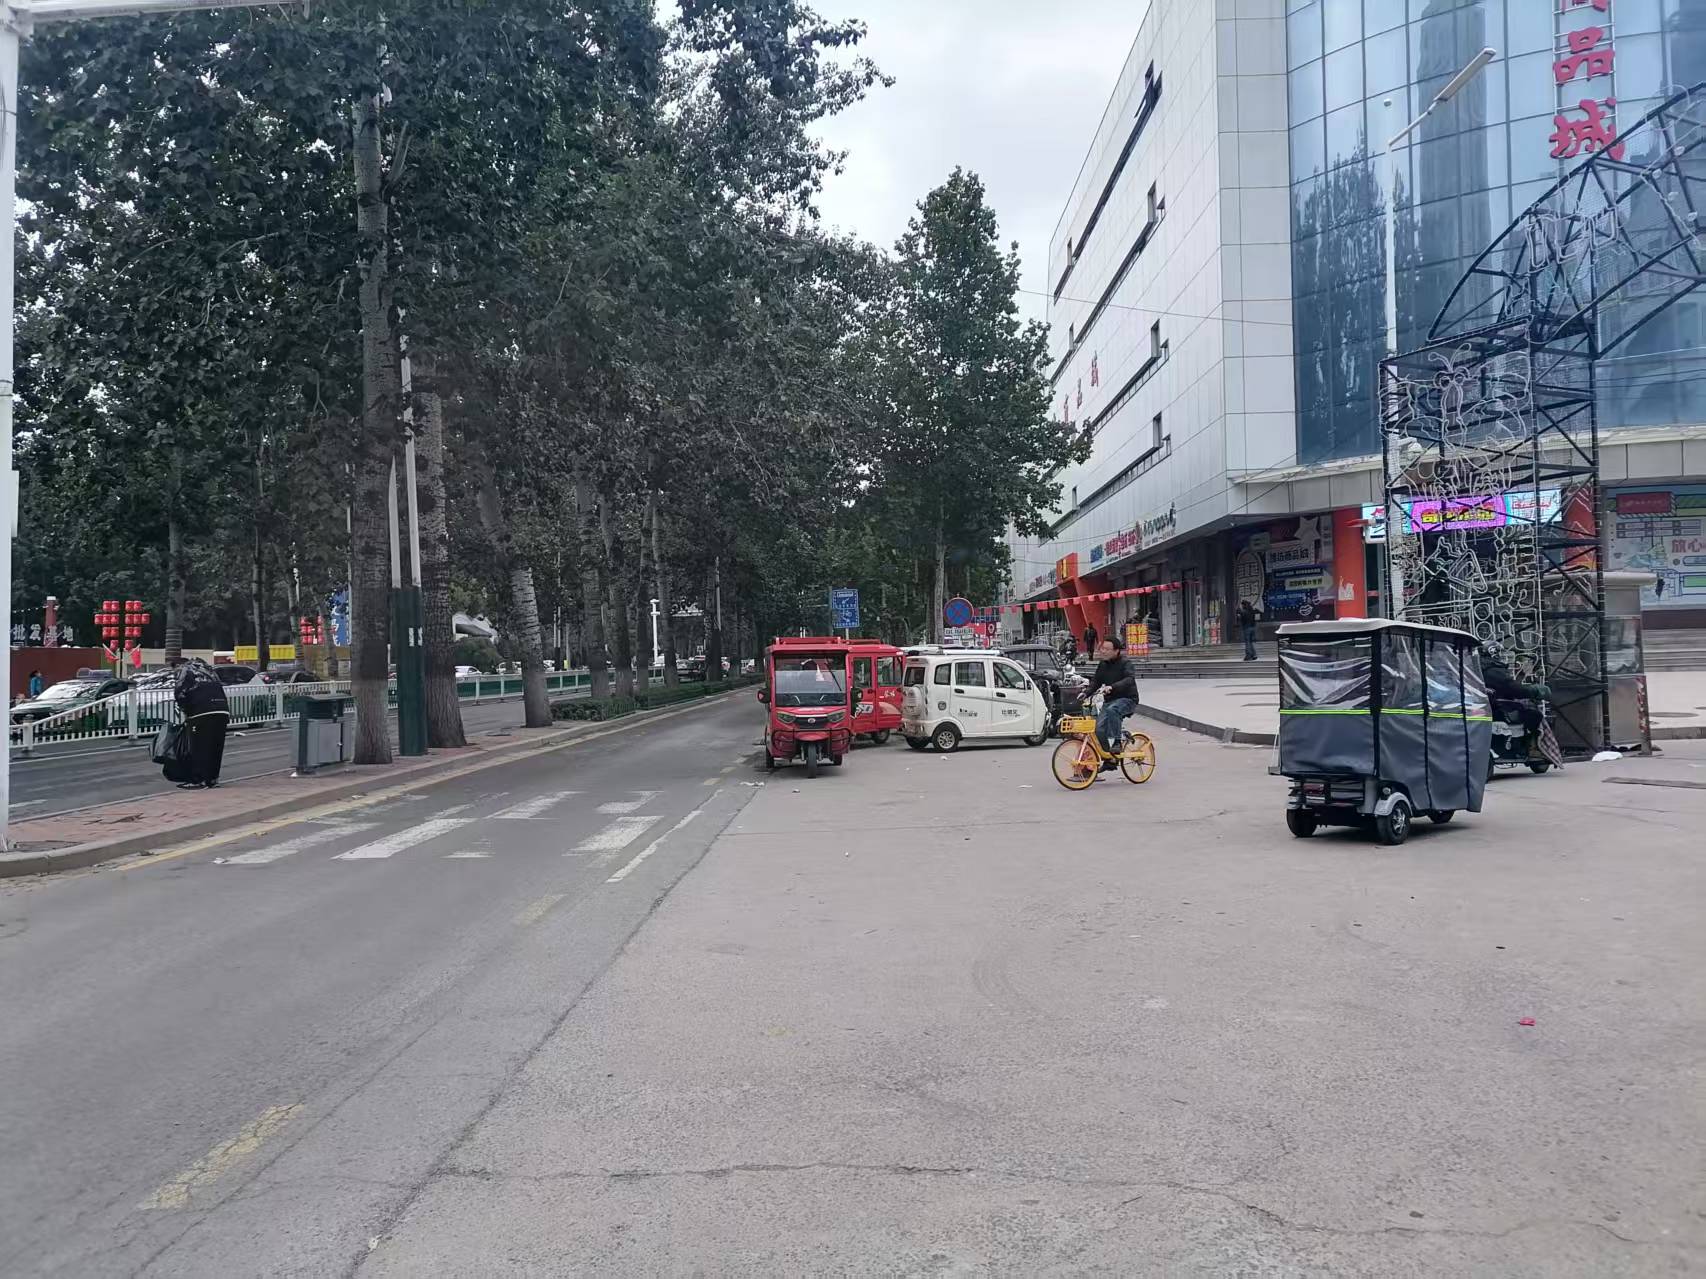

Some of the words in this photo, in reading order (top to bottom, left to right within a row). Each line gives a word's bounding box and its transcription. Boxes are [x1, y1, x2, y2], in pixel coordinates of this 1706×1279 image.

[1549, 0, 1625, 160] 品城
[1671, 538, 1706, 553] 放心
[13, 623, 74, 642] 批发基地
